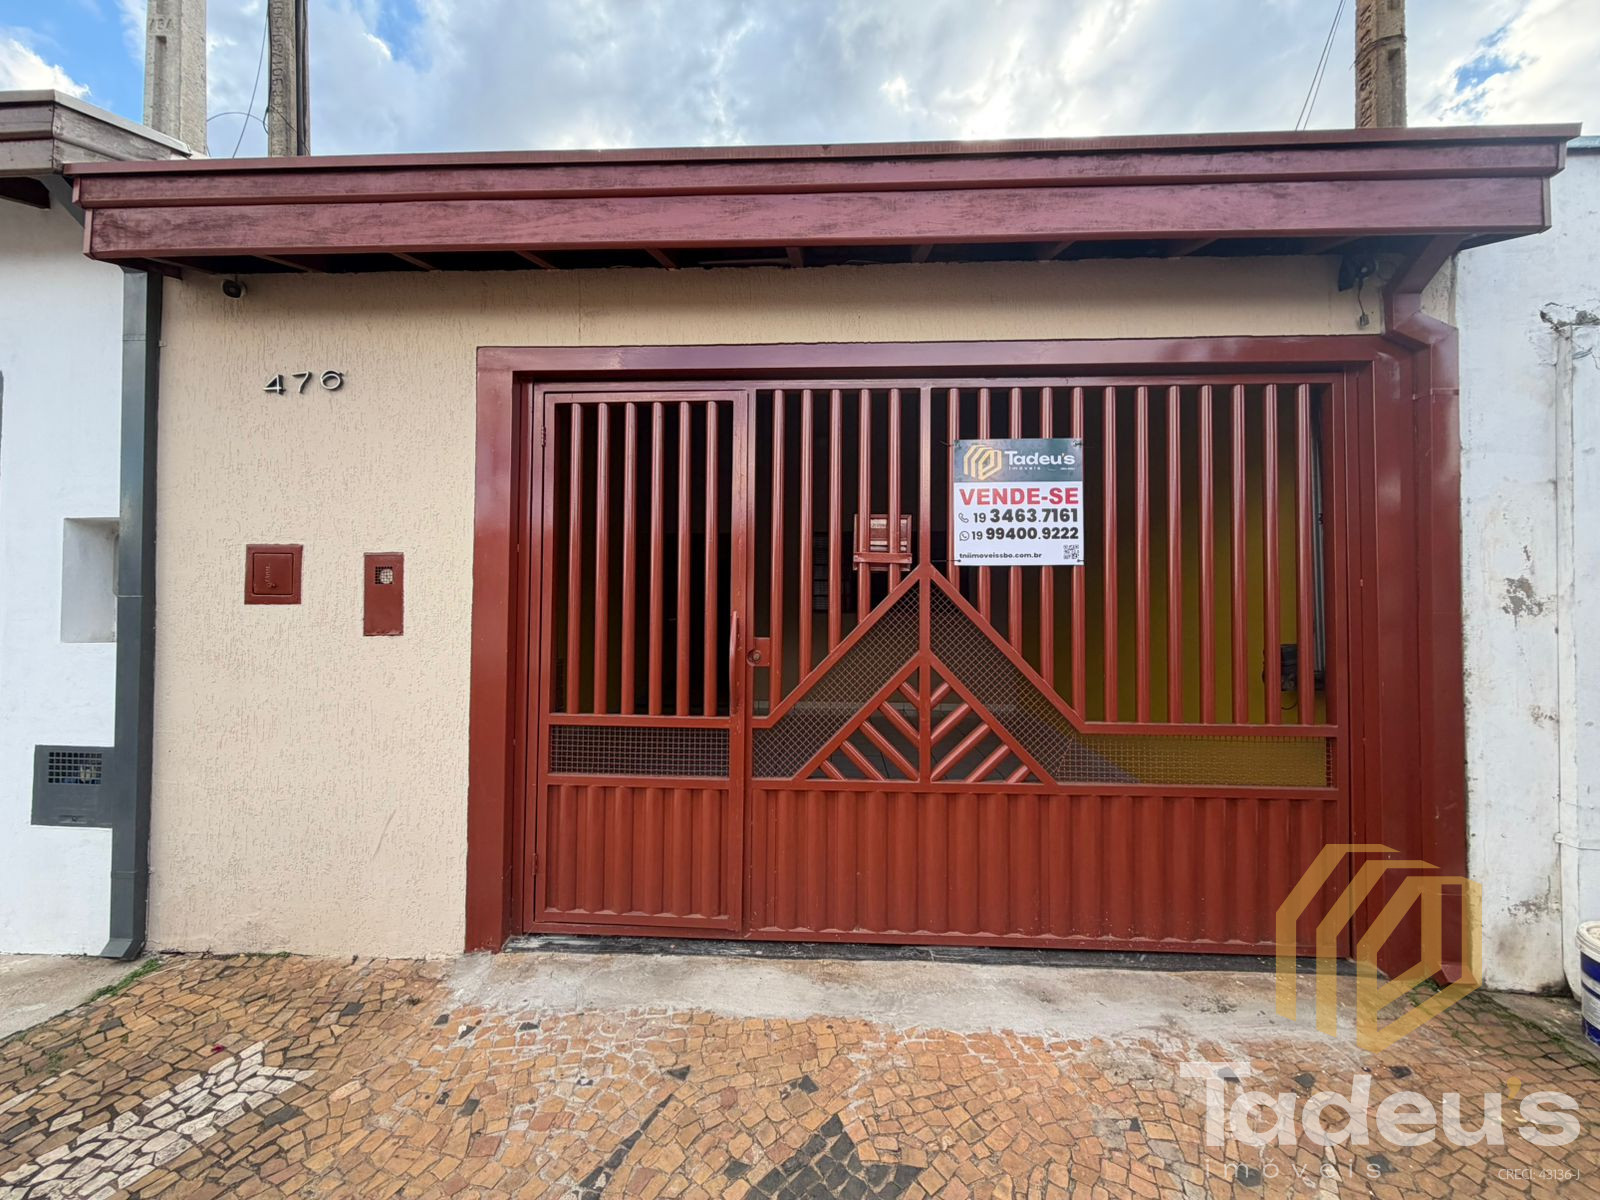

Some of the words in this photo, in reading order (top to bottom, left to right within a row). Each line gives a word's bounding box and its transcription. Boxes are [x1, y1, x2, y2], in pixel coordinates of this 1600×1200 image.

[263, 369, 344, 395] 476
[1004, 450, 1076, 466] Tadeu's
[959, 487, 1079, 506] VENDE-SE
[973, 512, 986, 523] 19
[989, 508, 1079, 523] 3463.7161
[971, 531, 983, 541] 19
[986, 527, 1079, 540] 99400.9222
